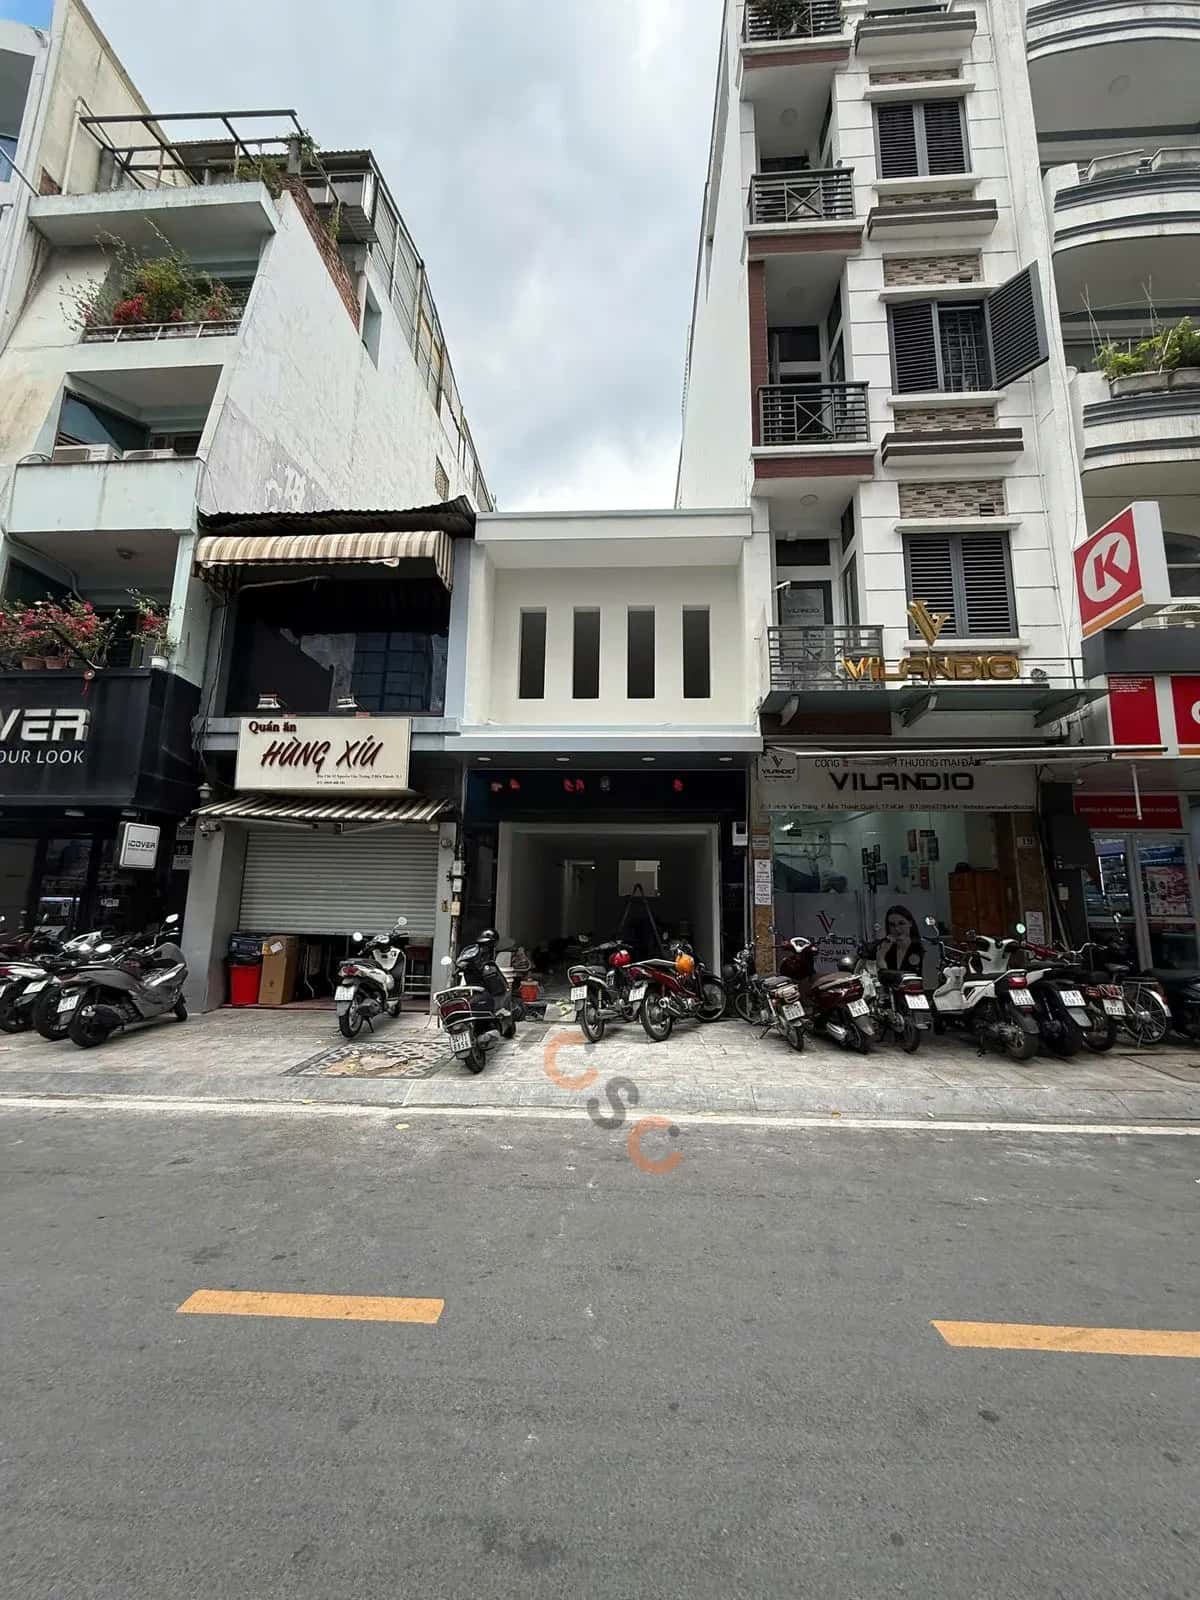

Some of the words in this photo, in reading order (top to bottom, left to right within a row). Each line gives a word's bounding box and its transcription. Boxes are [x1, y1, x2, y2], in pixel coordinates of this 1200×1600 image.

[841, 656, 1021, 682] VILANDIO
[36, 750, 84, 764] LOOK
[260, 736, 332, 774] HÙNG
[335, 735, 384, 768] XÍU
[828, 771, 974, 791] VILANDIO
